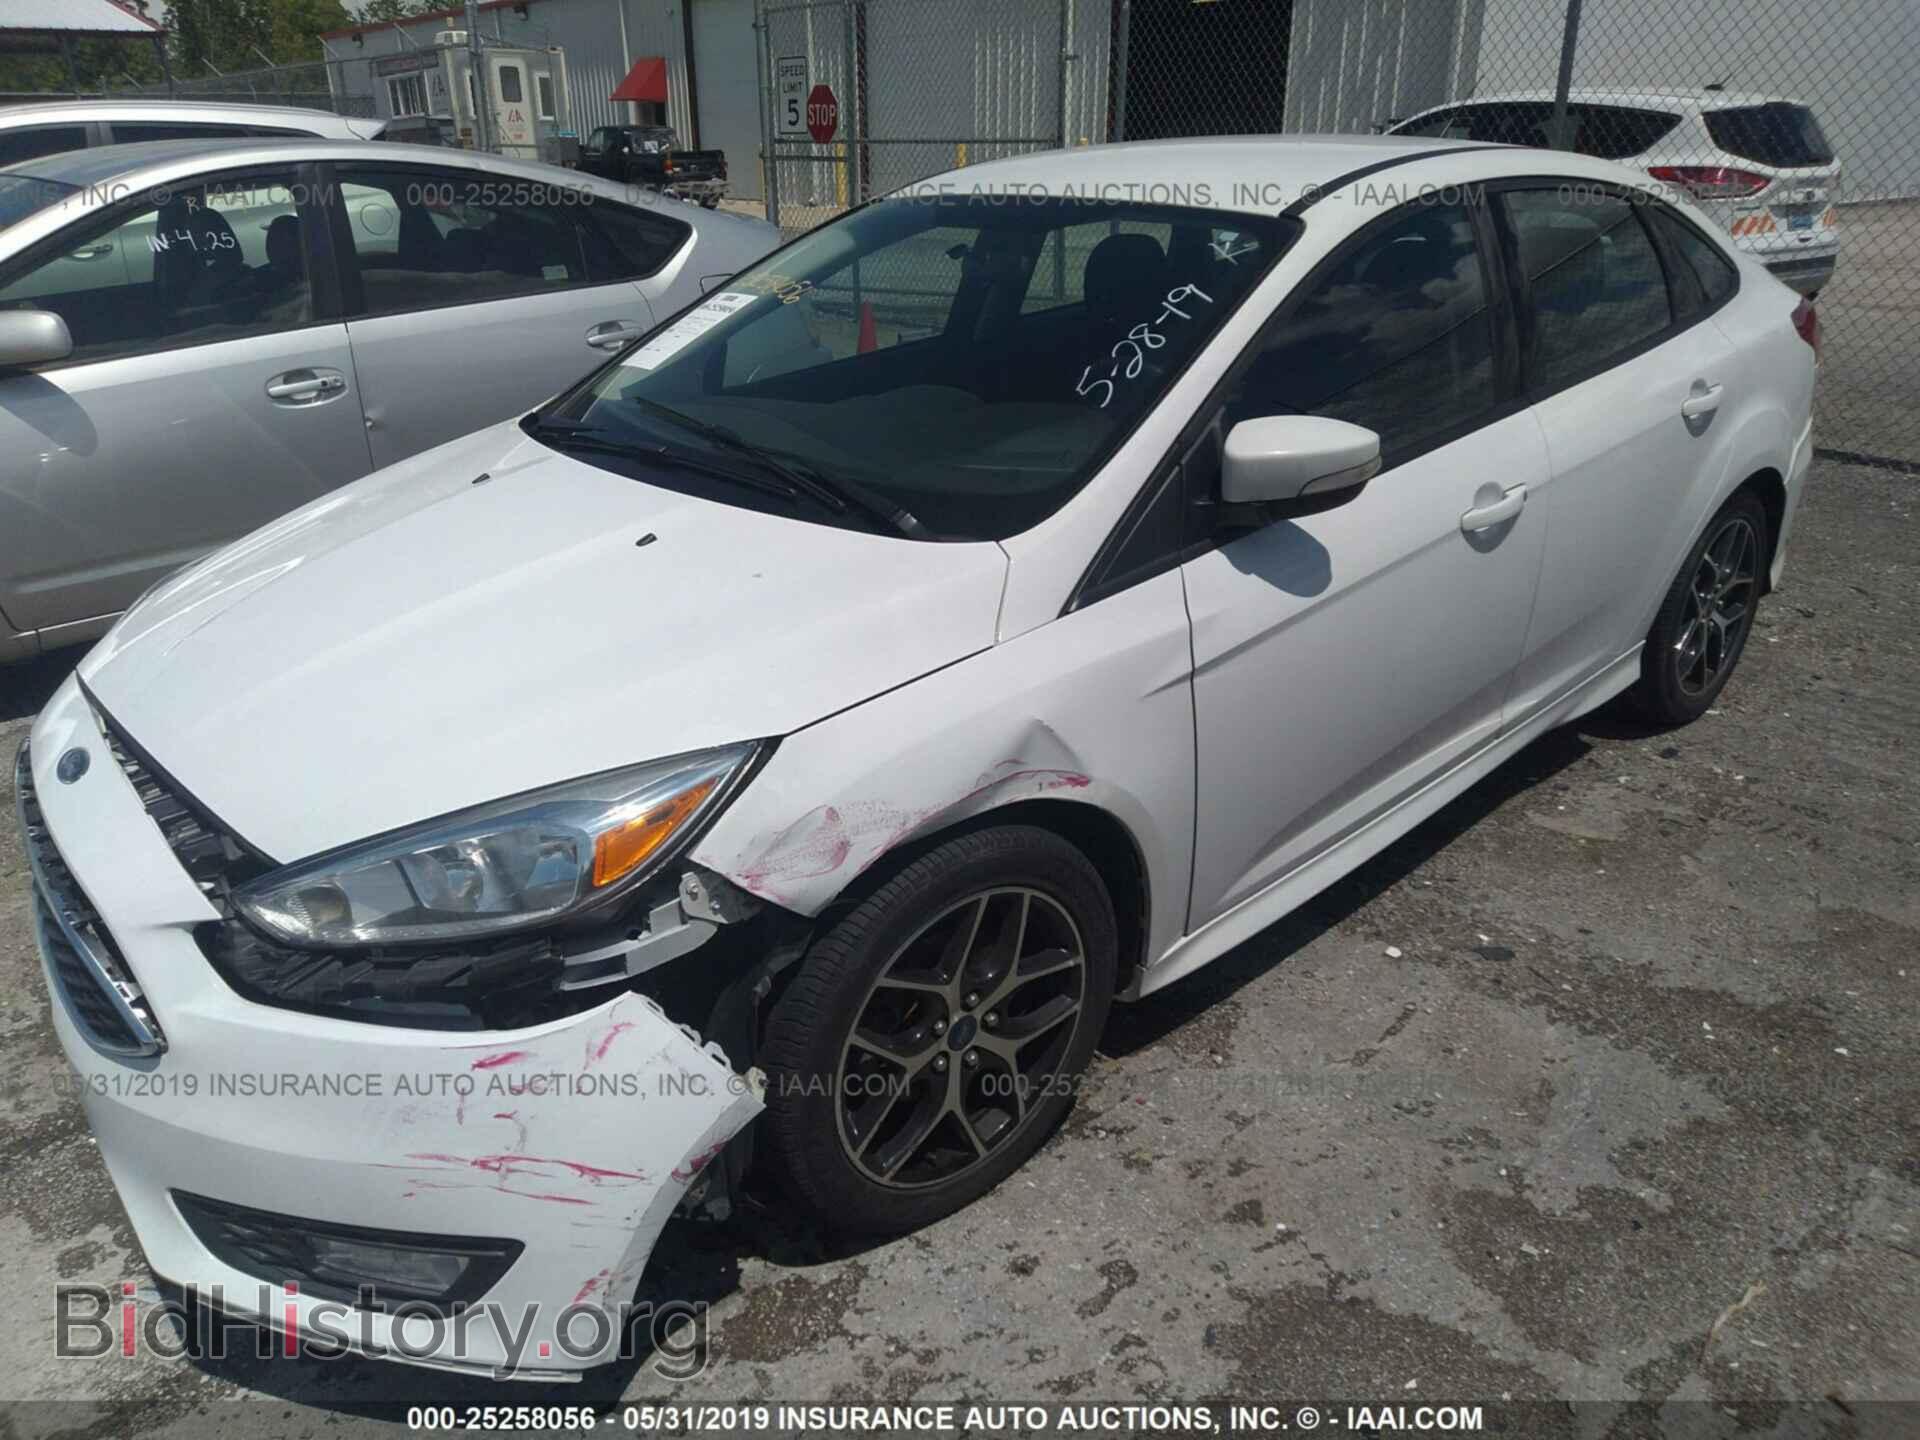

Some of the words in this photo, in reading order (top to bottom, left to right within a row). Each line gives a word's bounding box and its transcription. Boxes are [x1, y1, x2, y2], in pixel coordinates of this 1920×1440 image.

[781, 64, 805, 77] SPEED
[787, 98, 800, 127] 5
[807, 103, 836, 127] STOP
